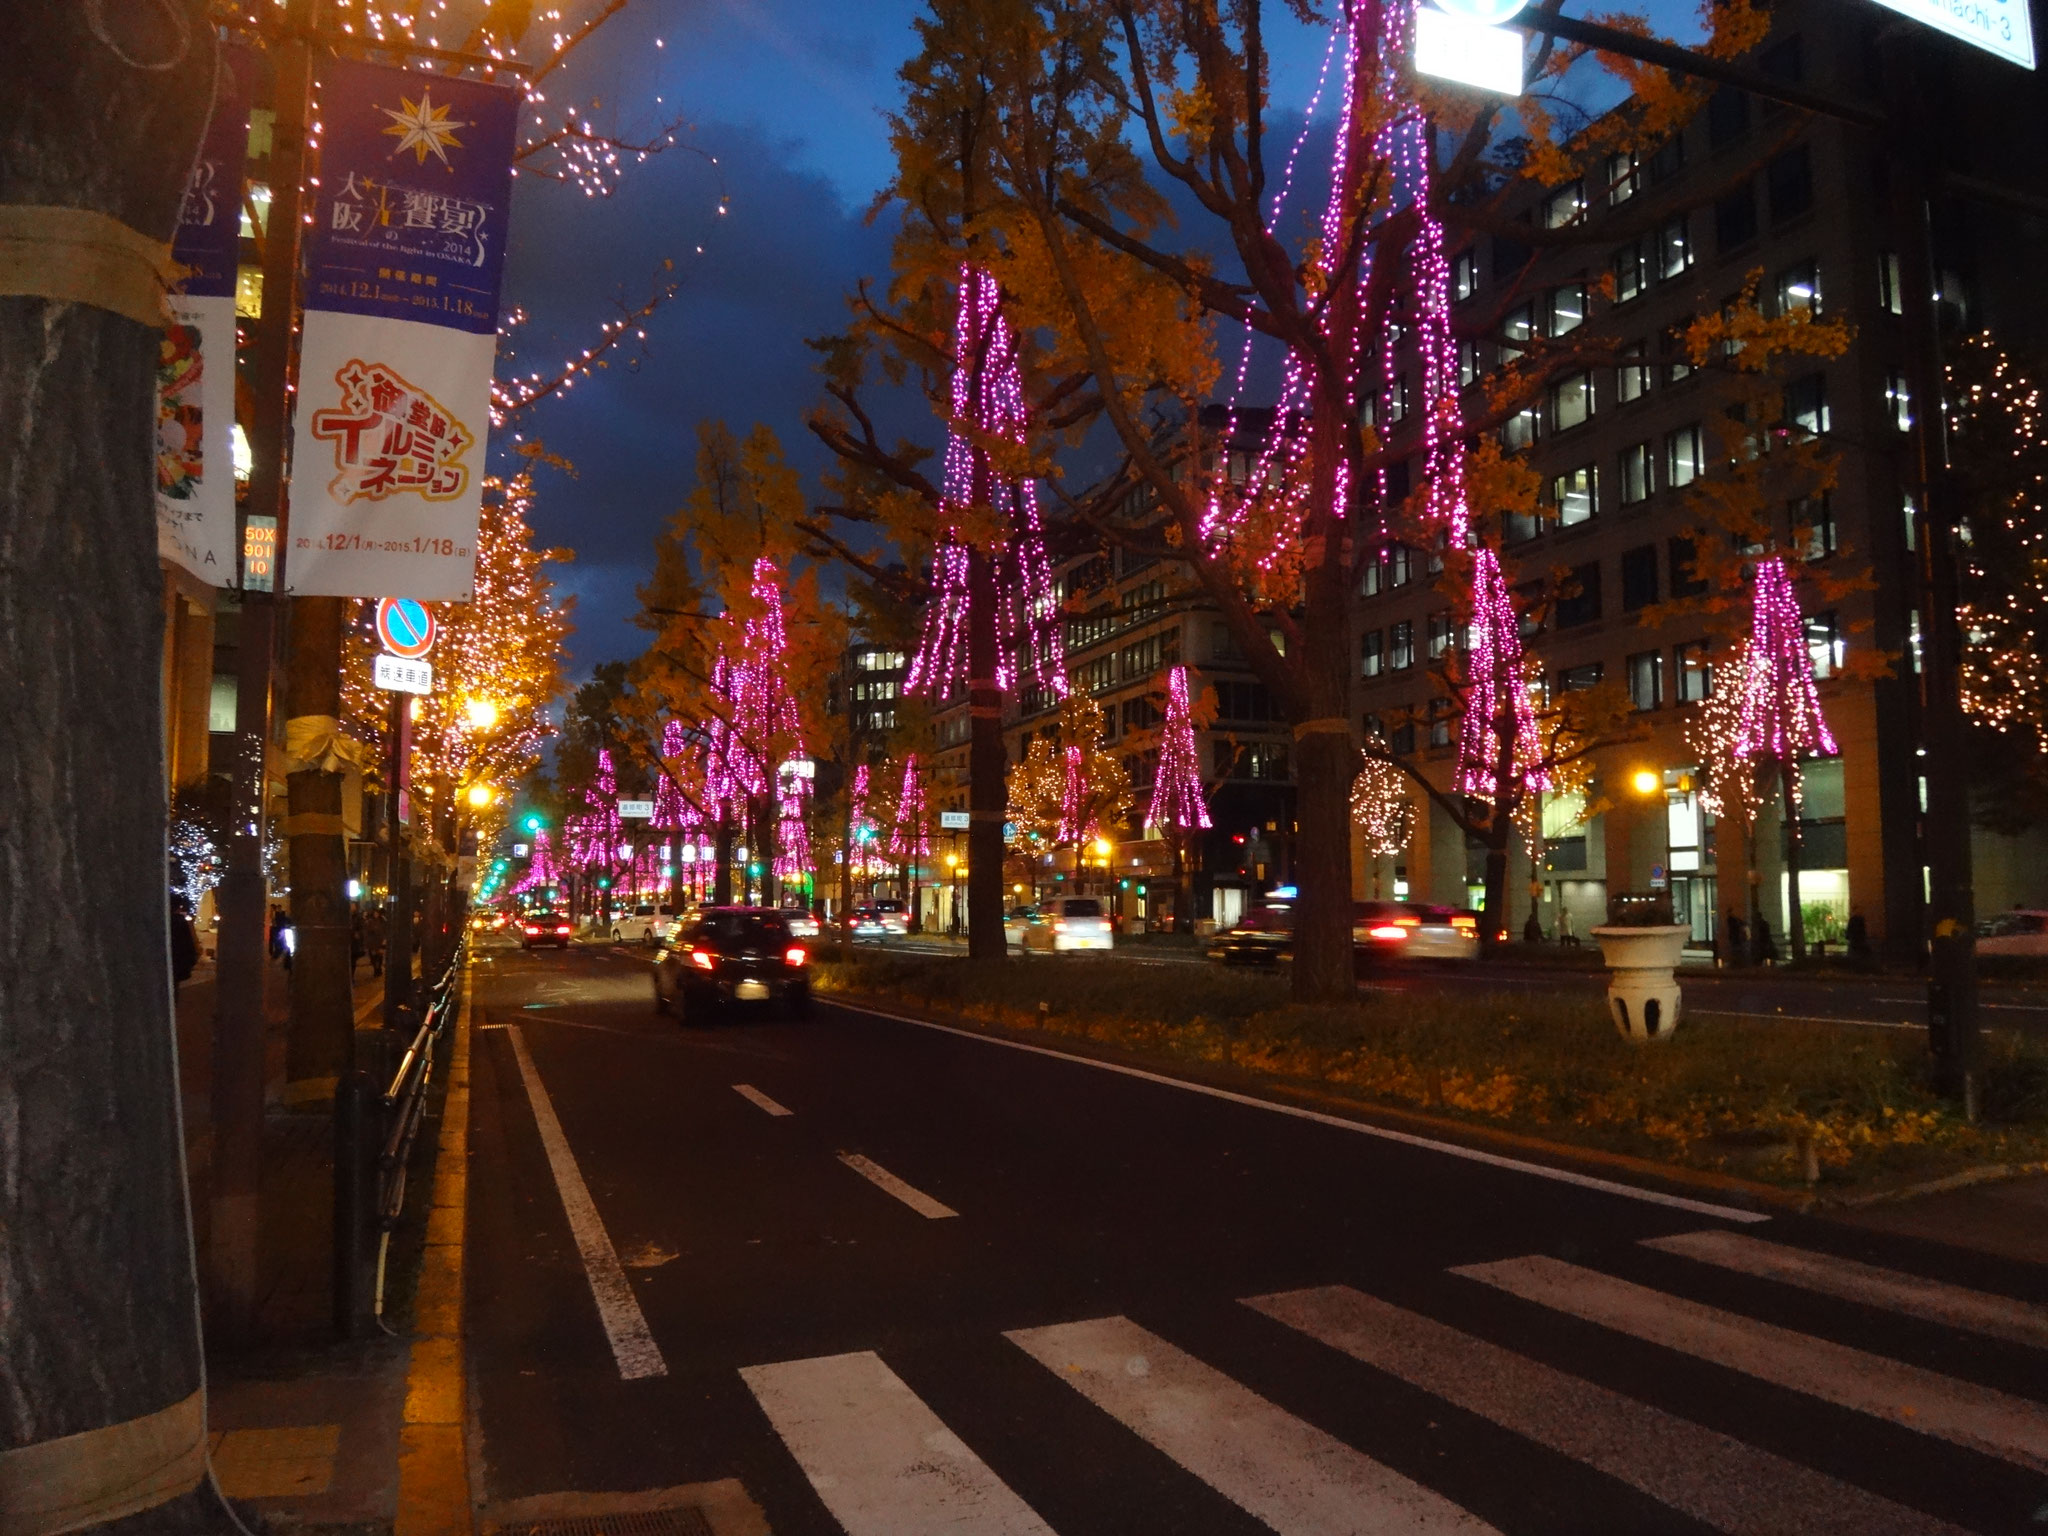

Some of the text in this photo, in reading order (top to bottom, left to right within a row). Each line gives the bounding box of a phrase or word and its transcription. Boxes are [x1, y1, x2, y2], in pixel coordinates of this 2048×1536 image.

[382, 241, 398, 251] the
[437, 252, 472, 264] OSAKA
[444, 241, 472, 255] 2014
[245, 527, 275, 543] 50X
